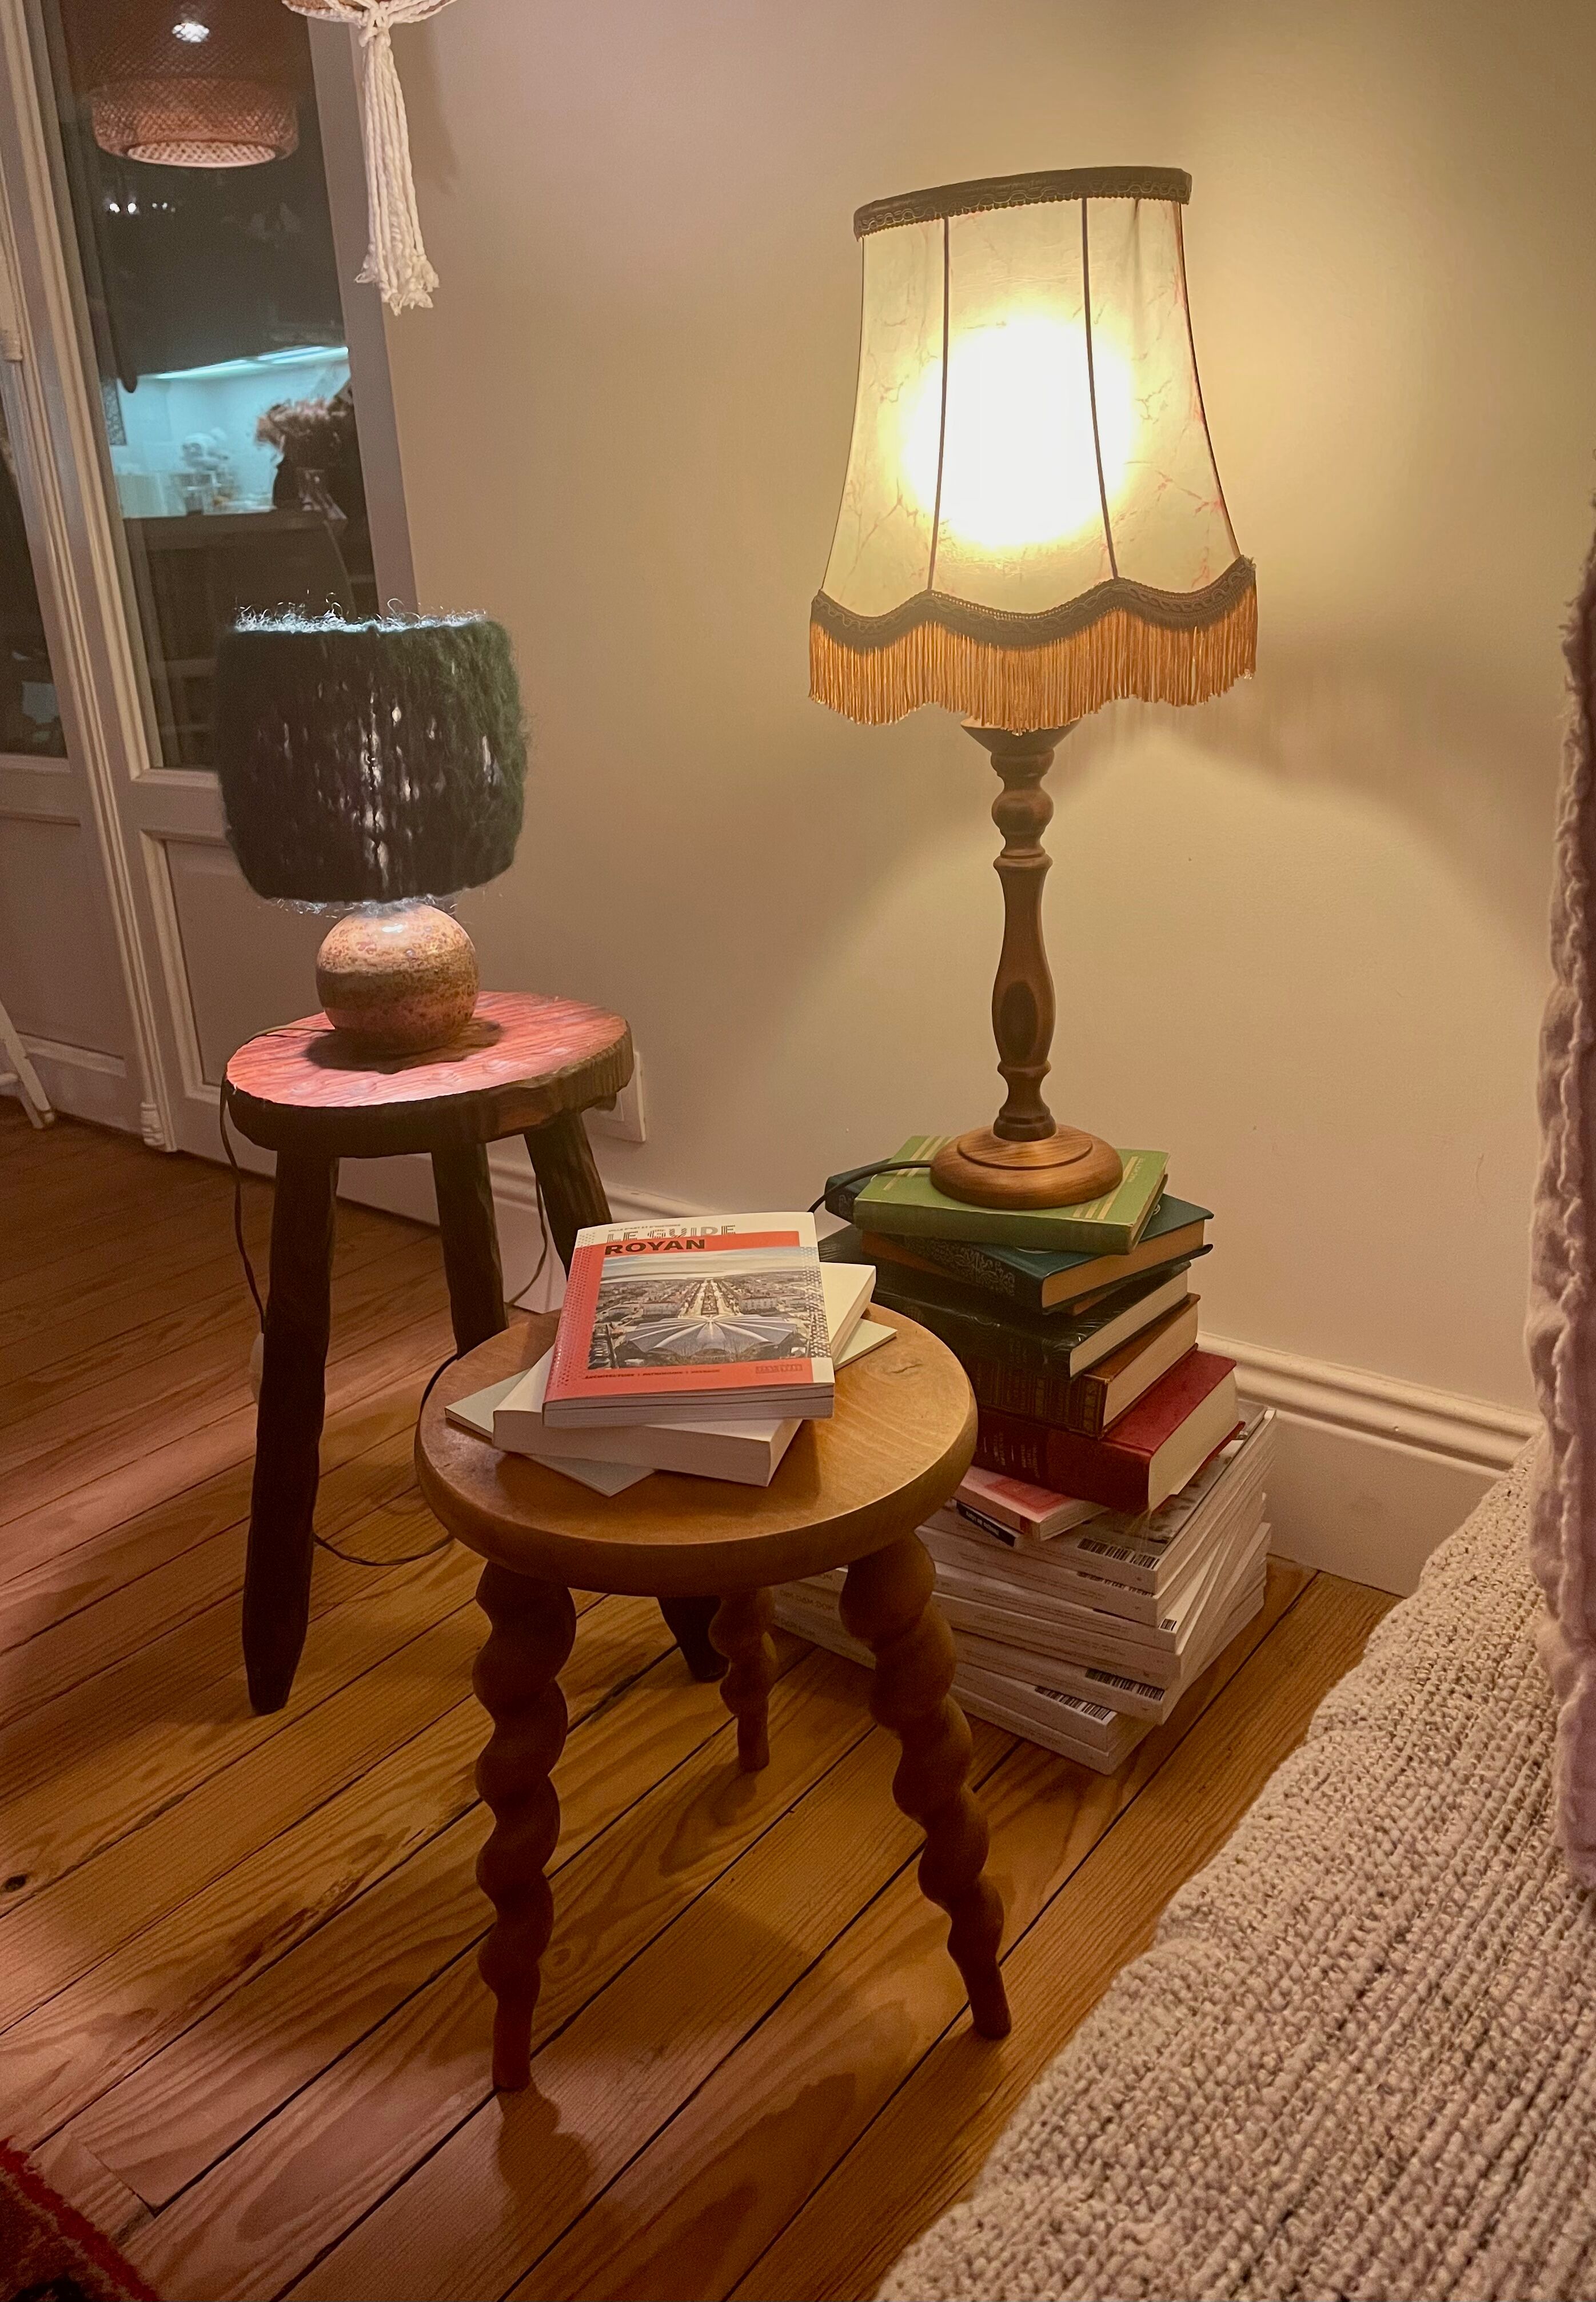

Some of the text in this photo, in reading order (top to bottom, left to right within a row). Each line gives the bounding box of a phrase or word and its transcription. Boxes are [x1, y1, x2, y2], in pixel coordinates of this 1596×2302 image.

[607, 1224, 736, 1243] LE GUIDE
[605, 1239, 705, 1255] ROYAN
